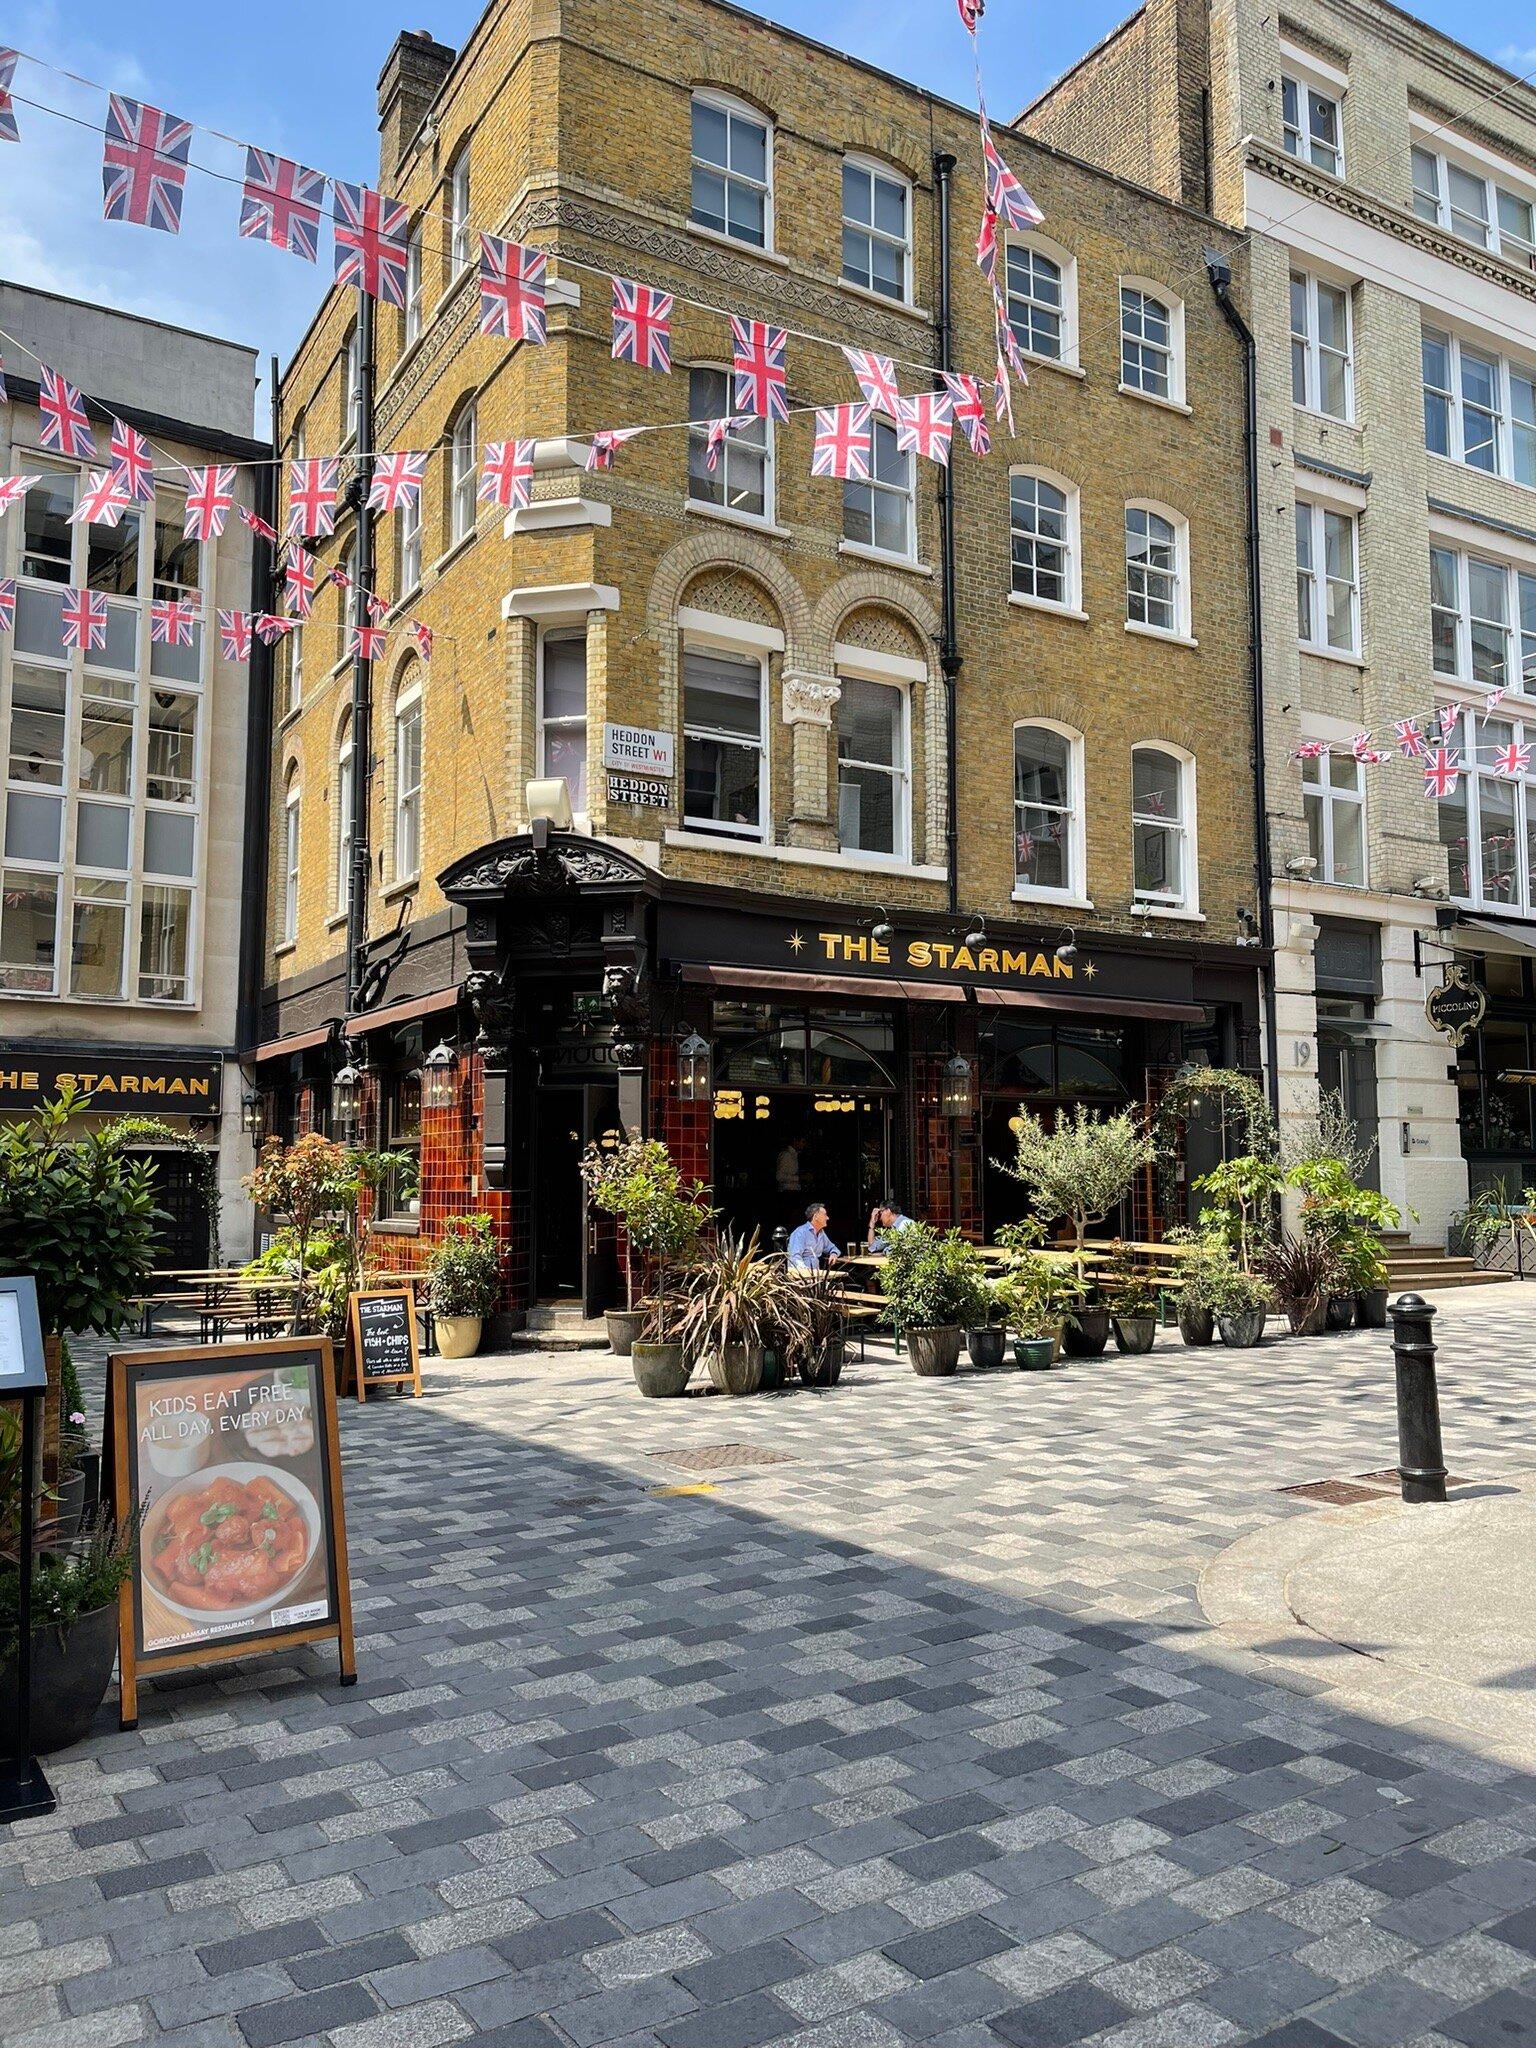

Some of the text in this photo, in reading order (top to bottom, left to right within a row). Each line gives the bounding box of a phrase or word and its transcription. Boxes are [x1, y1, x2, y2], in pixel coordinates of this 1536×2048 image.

[612, 729, 655, 747] HEDDON
[612, 743, 667, 762] STREET W1
[609, 776, 668, 796] HEDDON
[610, 789, 668, 807] STREET
[818, 932, 1074, 979] THE STARMAN
[1432, 1001, 1479, 1013] PICCOLINO
[1294, 1041, 1311, 1067] 19
[0, 1071, 209, 1095] HE STARMAN
[372, 1304, 403, 1313] STARMAN
[364, 1337, 381, 1347] FISH
[386, 1335, 409, 1346] CHIPS
[150, 1383, 294, 1418] KIDS EAT FREE
[140, 1406, 305, 1443] ALL DAY, EVERY DAY
[147, 1635, 179, 1647] GORDON
[181, 1628, 209, 1640] RAMSAY
[210, 1618, 255, 1634] RESTAURANTS
